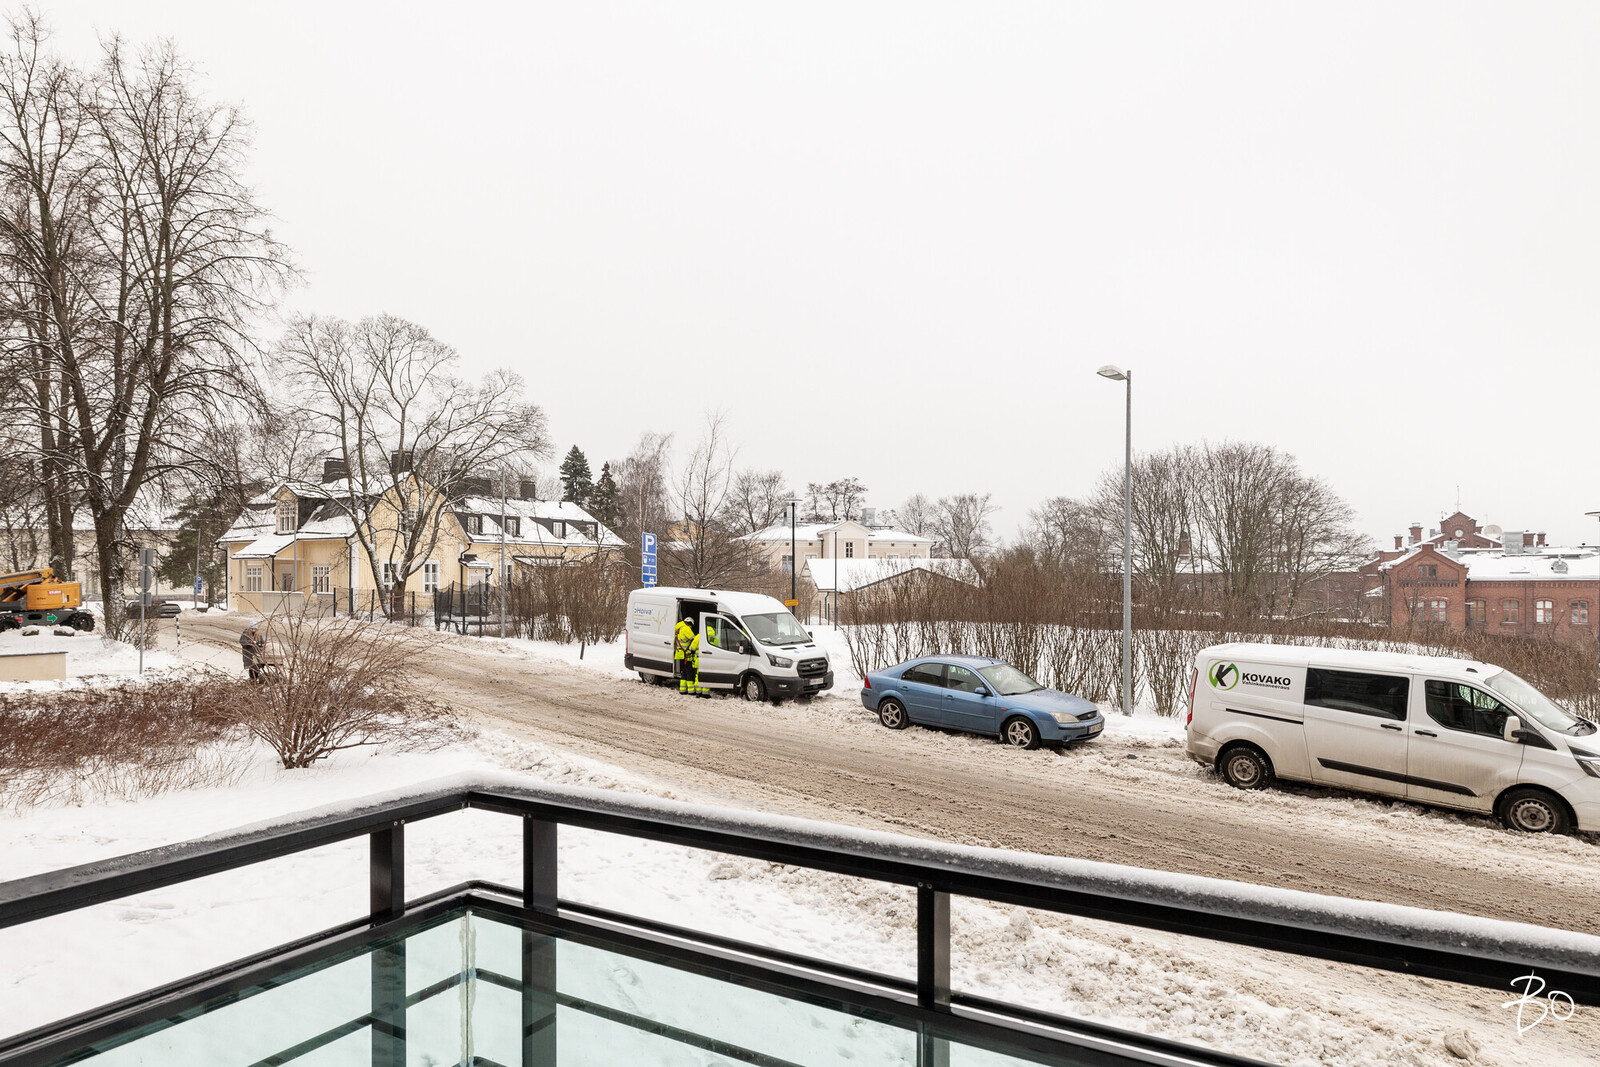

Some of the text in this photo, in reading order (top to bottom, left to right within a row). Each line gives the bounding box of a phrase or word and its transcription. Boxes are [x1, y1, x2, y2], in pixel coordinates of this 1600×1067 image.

[645, 535, 654, 551] P
[1241, 681, 1290, 690] Vahinkosaneeraus
[1242, 673, 1291, 686] KOVAKO
